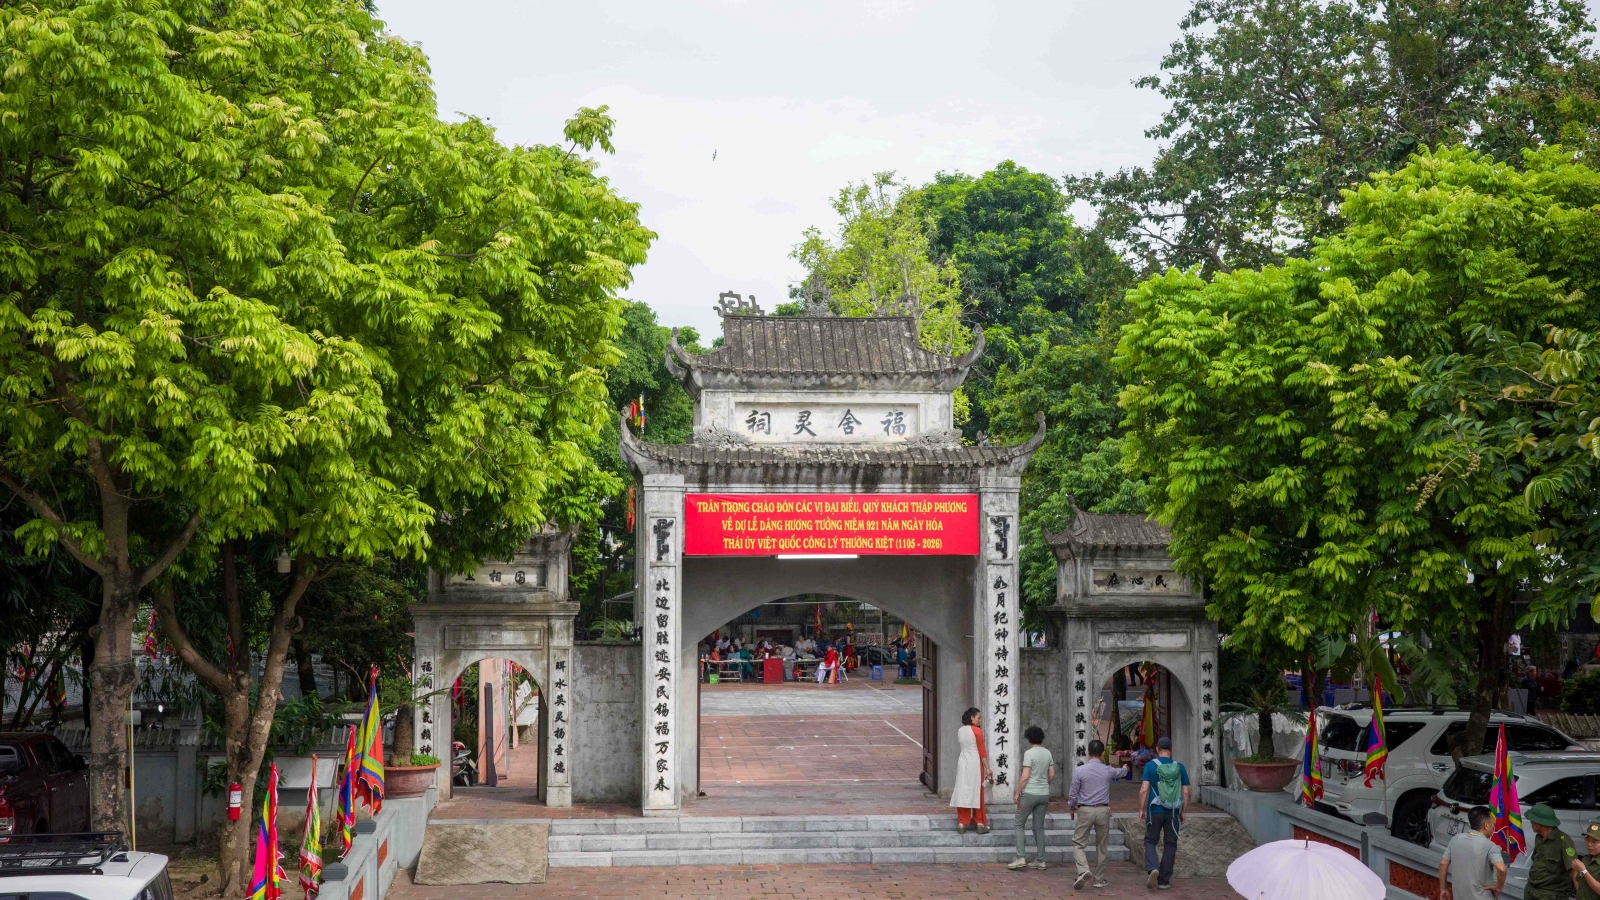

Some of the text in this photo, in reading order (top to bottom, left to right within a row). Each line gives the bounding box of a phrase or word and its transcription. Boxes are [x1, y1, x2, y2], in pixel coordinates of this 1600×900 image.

[697, 496, 967, 516] TRÂN TRỌNG CHÀO ĐÓN CÁC VỊ ĐẠI BIỂU, QUÝ KHÁCH THẬP PHƯƠNG
[721, 515, 944, 534] VỀ DỰ LỄ DÂNG HƯƠNG TƯỞNG NIỆM 921 NĂM NGÀY HÓA
[723, 535, 744, 549] THÁI
[757, 535, 777, 552] VIỆT
[778, 534, 802, 550] QUỐC
[803, 535, 827, 549] CÔNG
[828, 535, 839, 549] LÝ
[840, 535, 874, 549] THƯỜNG
[875, 535, 894, 552] KIỆT
[895, 538, 916, 550] (1105
[922, 538, 943, 550] 2026)
